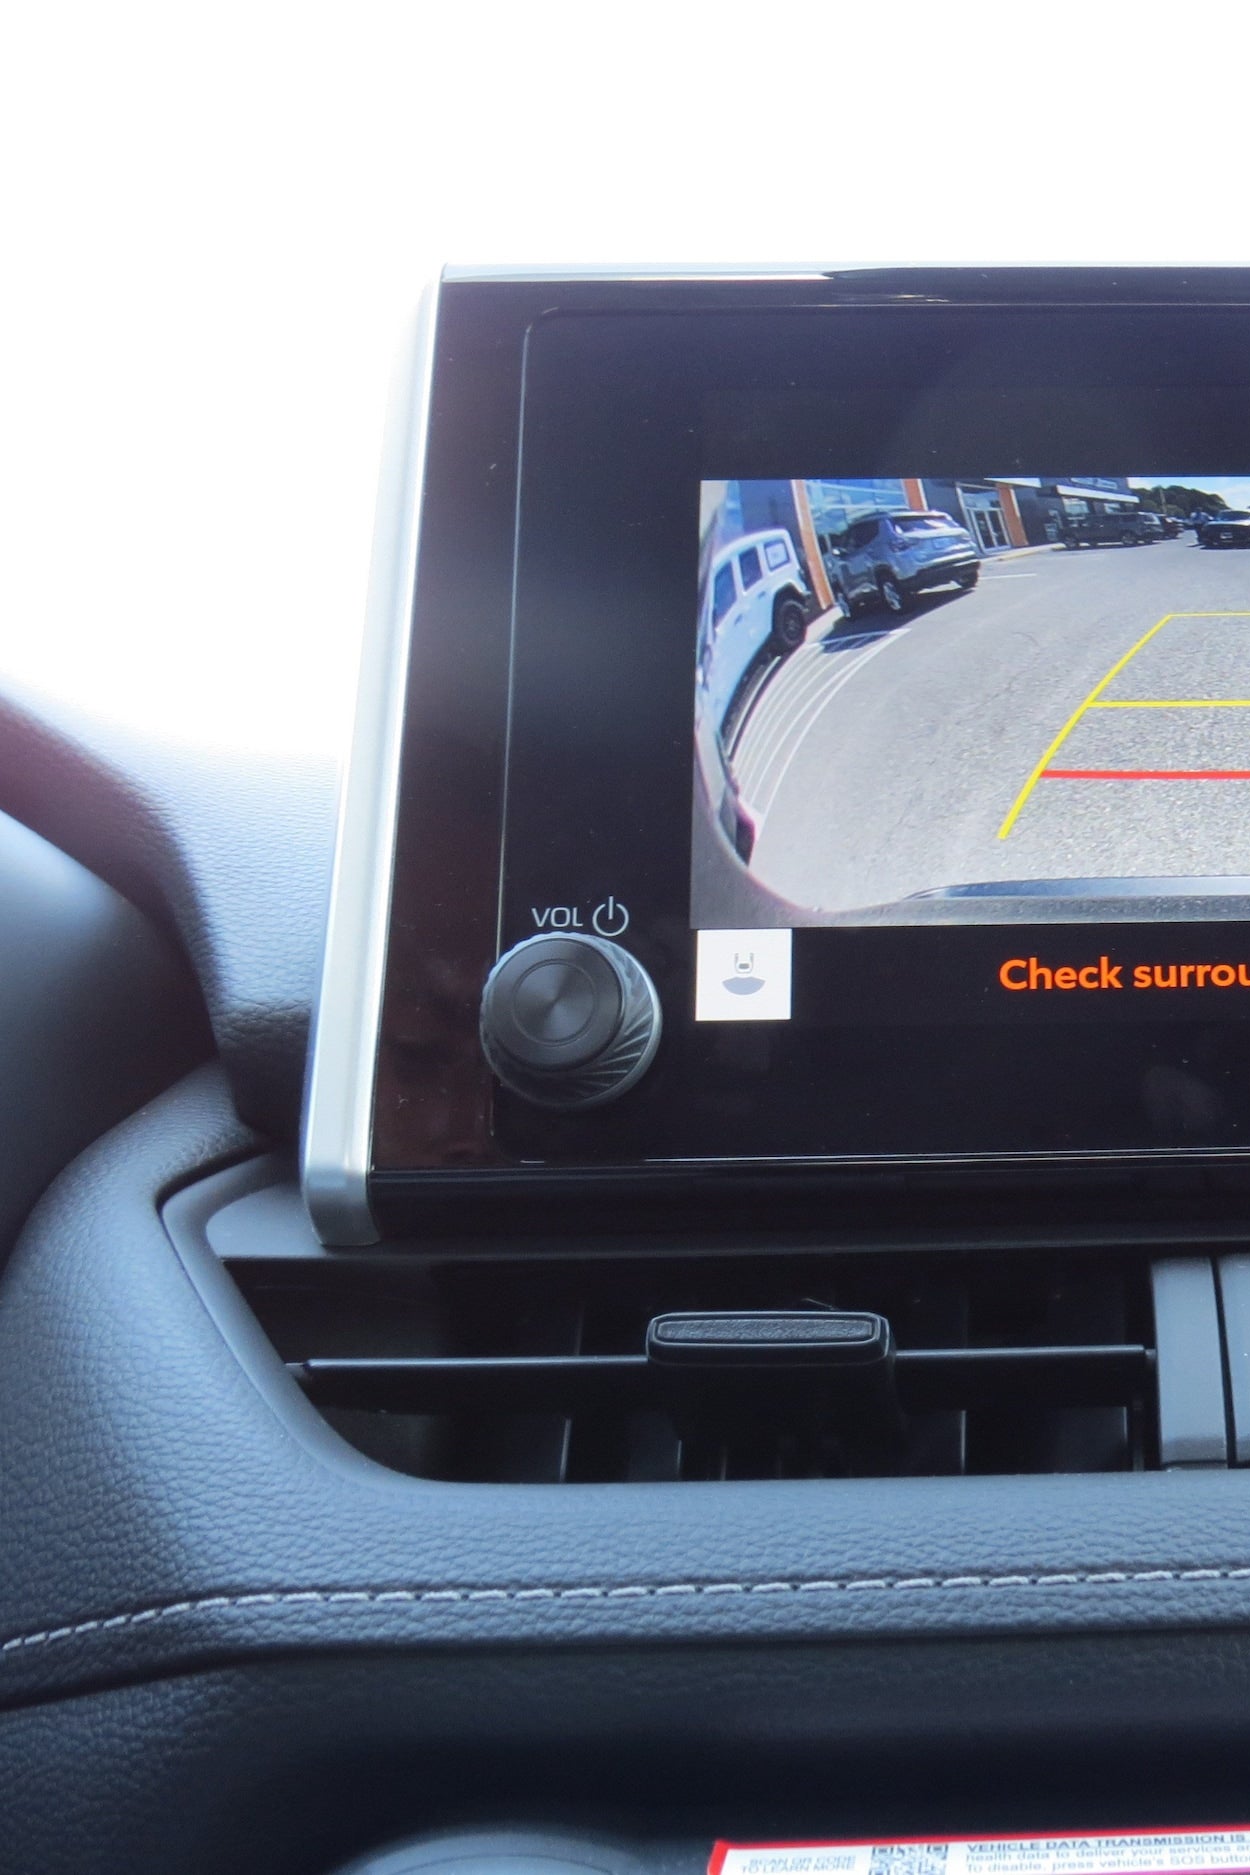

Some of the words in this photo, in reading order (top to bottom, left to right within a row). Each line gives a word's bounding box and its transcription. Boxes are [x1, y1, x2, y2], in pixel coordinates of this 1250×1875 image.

[532, 906, 584, 928] VOL
[998, 956, 1123, 991] Check
[966, 1842, 1039, 1853] VEHICLE
[1045, 1840, 1090, 1850] DATA
[1096, 1834, 1225, 1849] TRANSMISSION
[1230, 1834, 1246, 1843] IS
[966, 1851, 1012, 1862] health
[1017, 1851, 1050, 1861] data
[1056, 1850, 1070, 1859] to
[1076, 1848, 1125, 1858] deliver
[1132, 1848, 1162, 1858] your
[1169, 1844, 1231, 1854] services
[988, 1862, 1046, 1873] disable,
[1052, 1860, 1094, 1873] press
[1099, 1856, 1164, 1868] vehicle's
[1170, 1855, 1205, 1865] SOS
